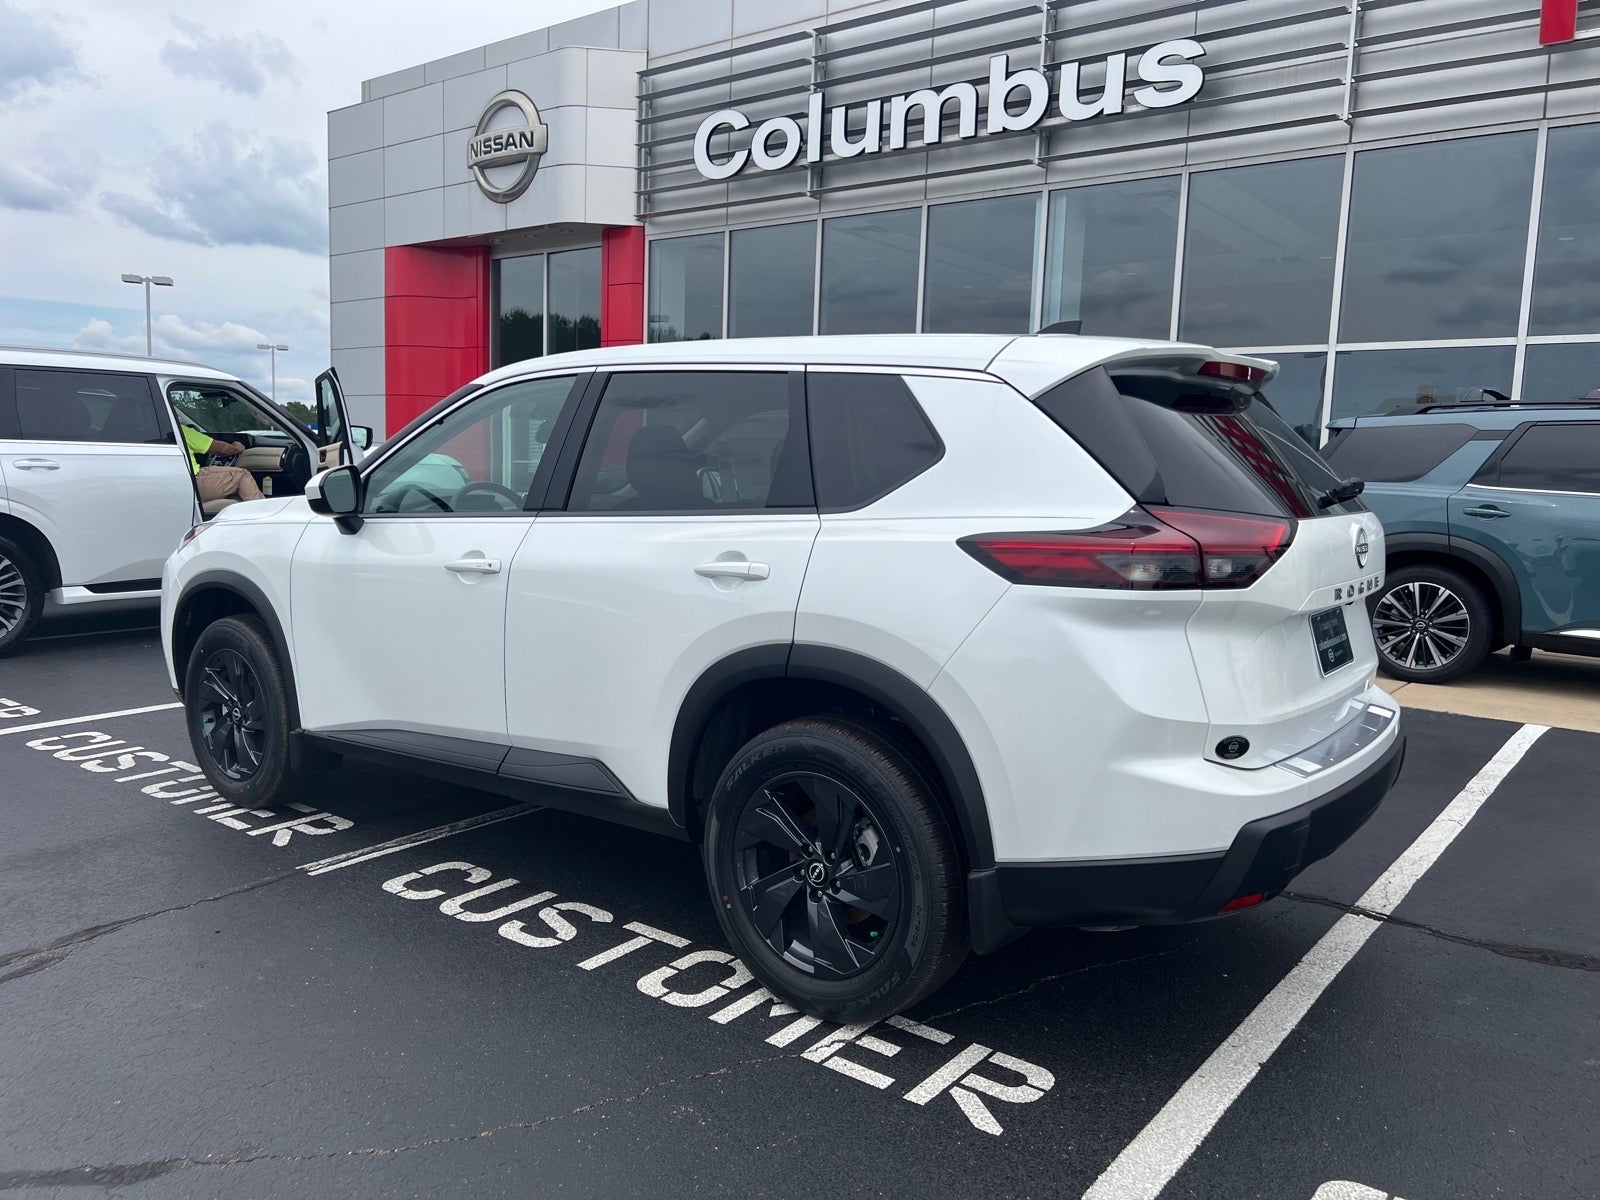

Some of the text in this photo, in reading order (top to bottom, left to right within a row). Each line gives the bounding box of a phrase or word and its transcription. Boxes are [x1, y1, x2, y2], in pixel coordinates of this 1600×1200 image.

[470, 130, 535, 160] NISSAN
[693, 38, 1206, 181] Columbus
[1334, 576, 1379, 601] ROGUE
[380, 860, 1056, 1137] CUSTOMER
